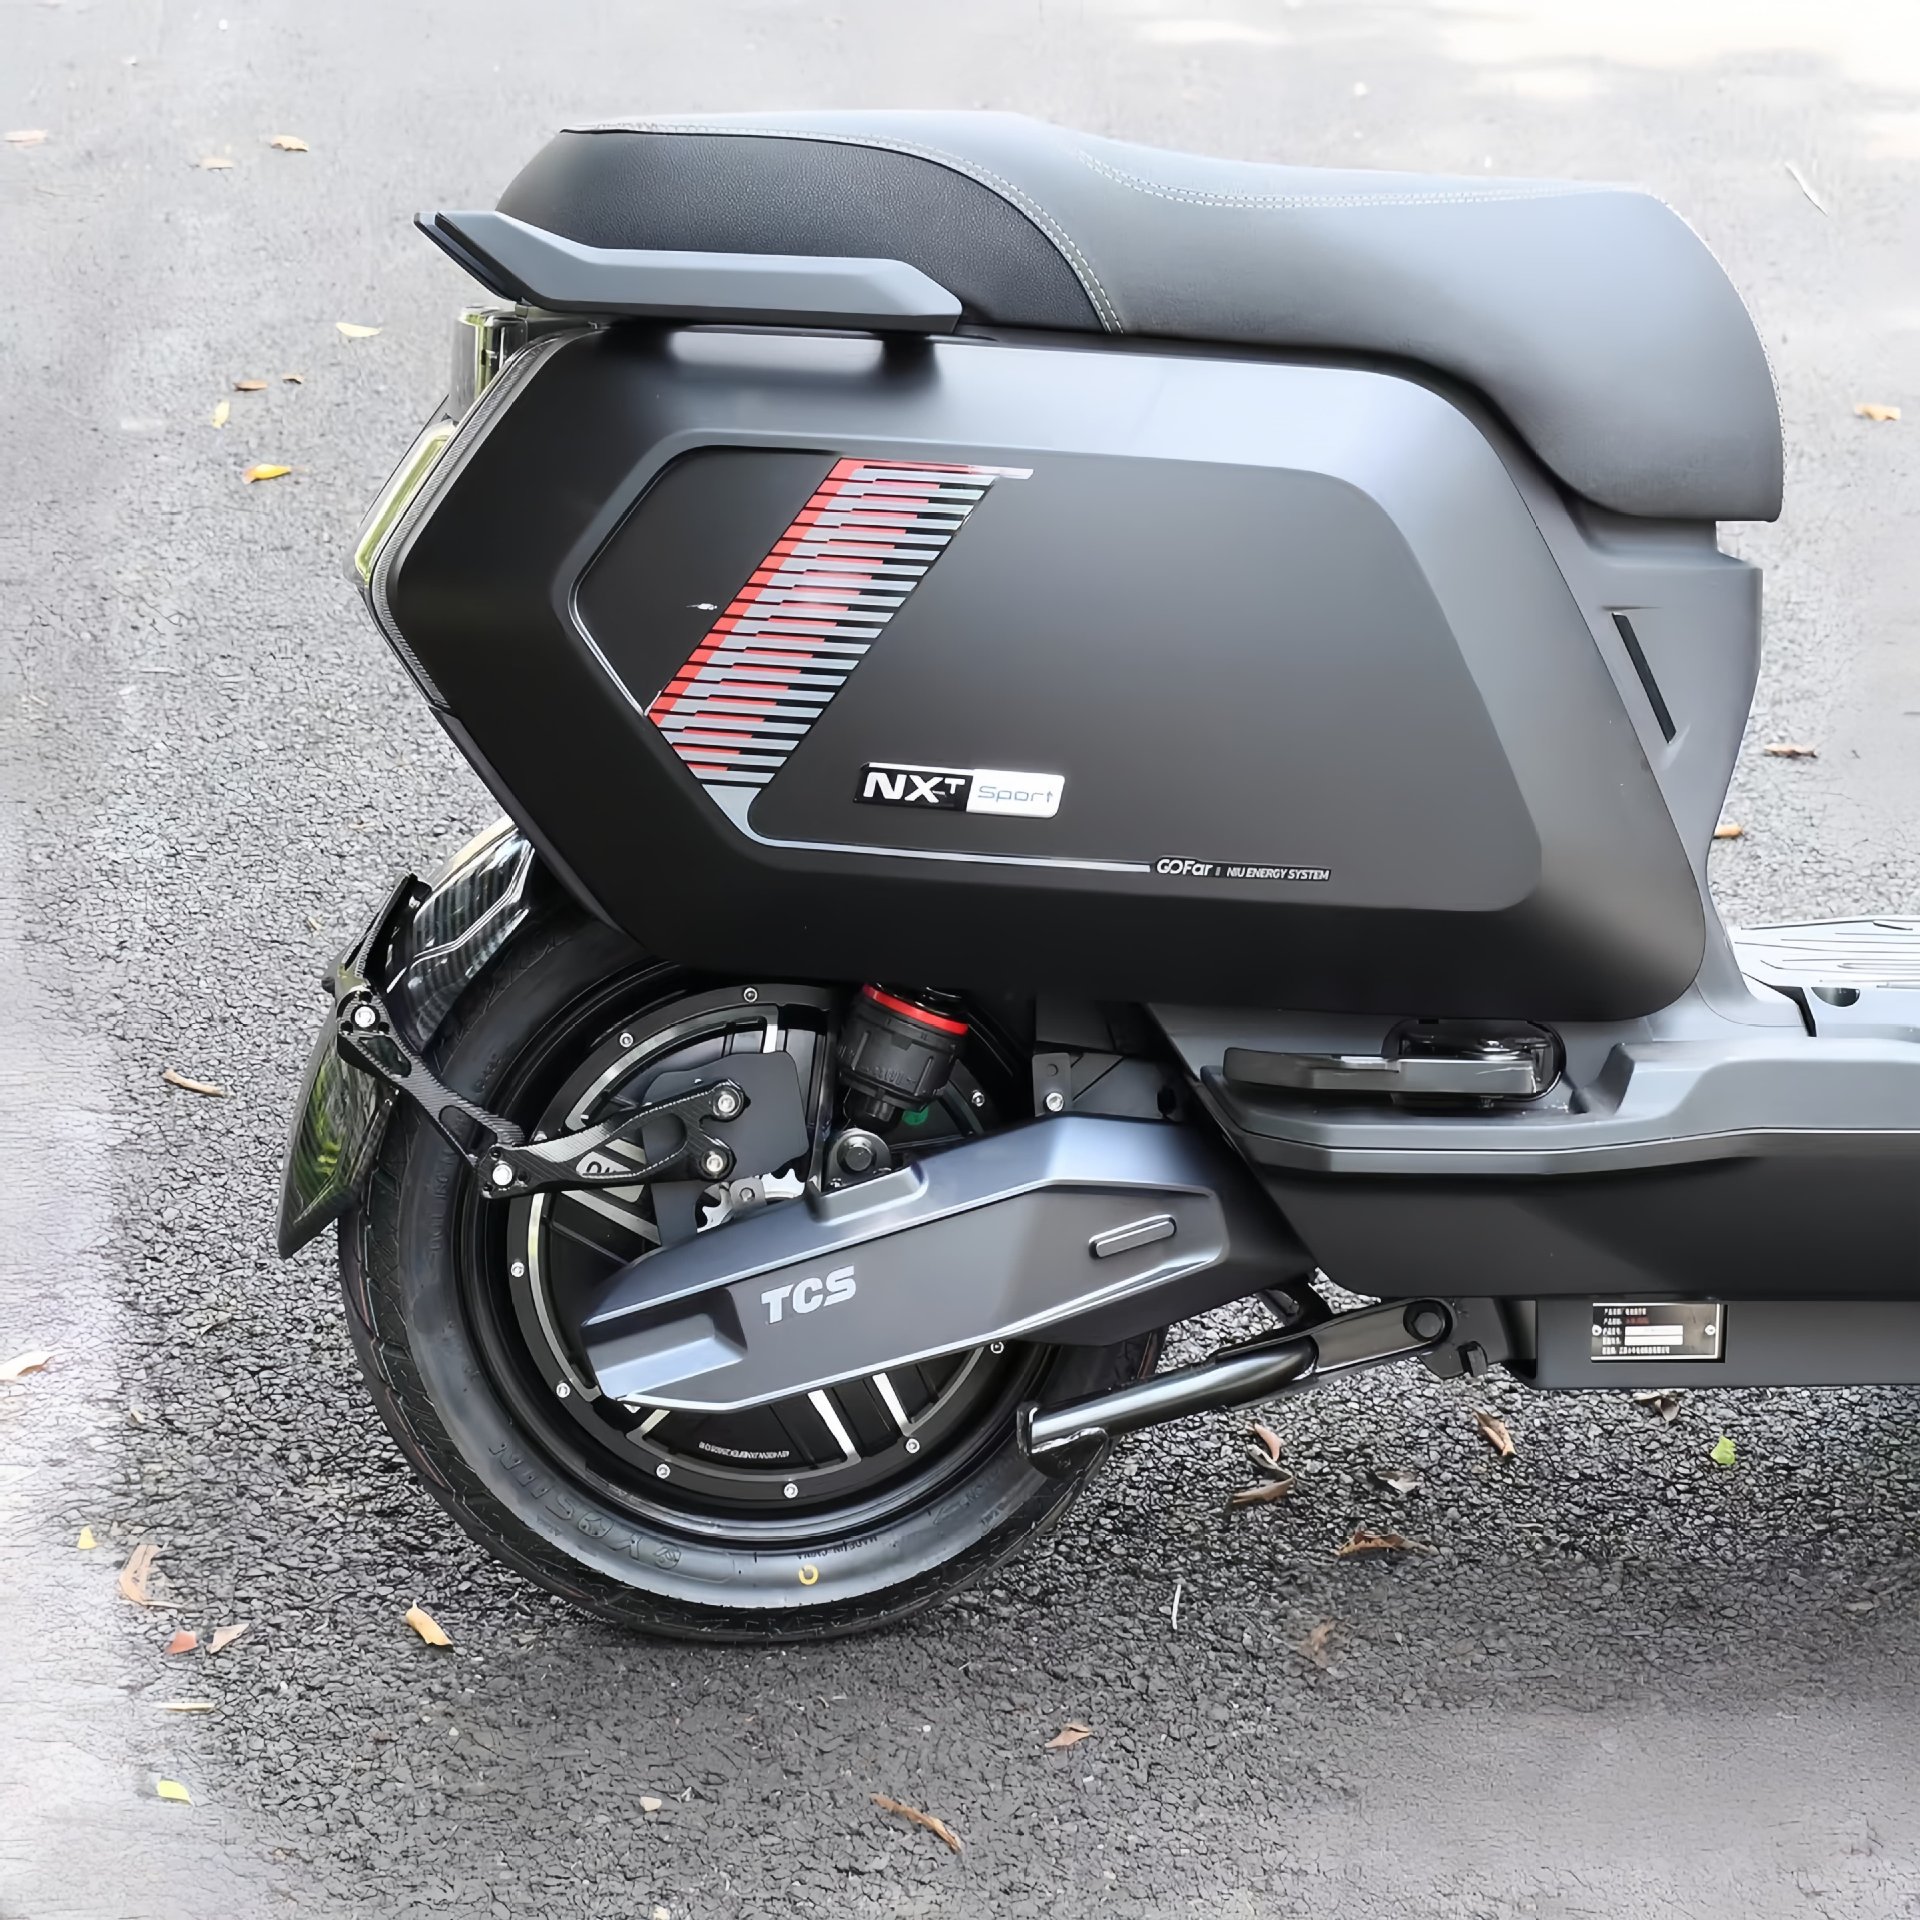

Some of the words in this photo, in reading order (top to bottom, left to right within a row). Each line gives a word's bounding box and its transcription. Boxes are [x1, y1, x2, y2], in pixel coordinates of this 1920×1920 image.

[978, 786, 1053, 803] Sport
[1156, 858, 1213, 876] GOFar
[1226, 866, 1246, 877] NIU
[1245, 867, 1288, 879] ENERGY
[1287, 869, 1330, 880] SYSTEM
[761, 1265, 856, 1324] TCS
